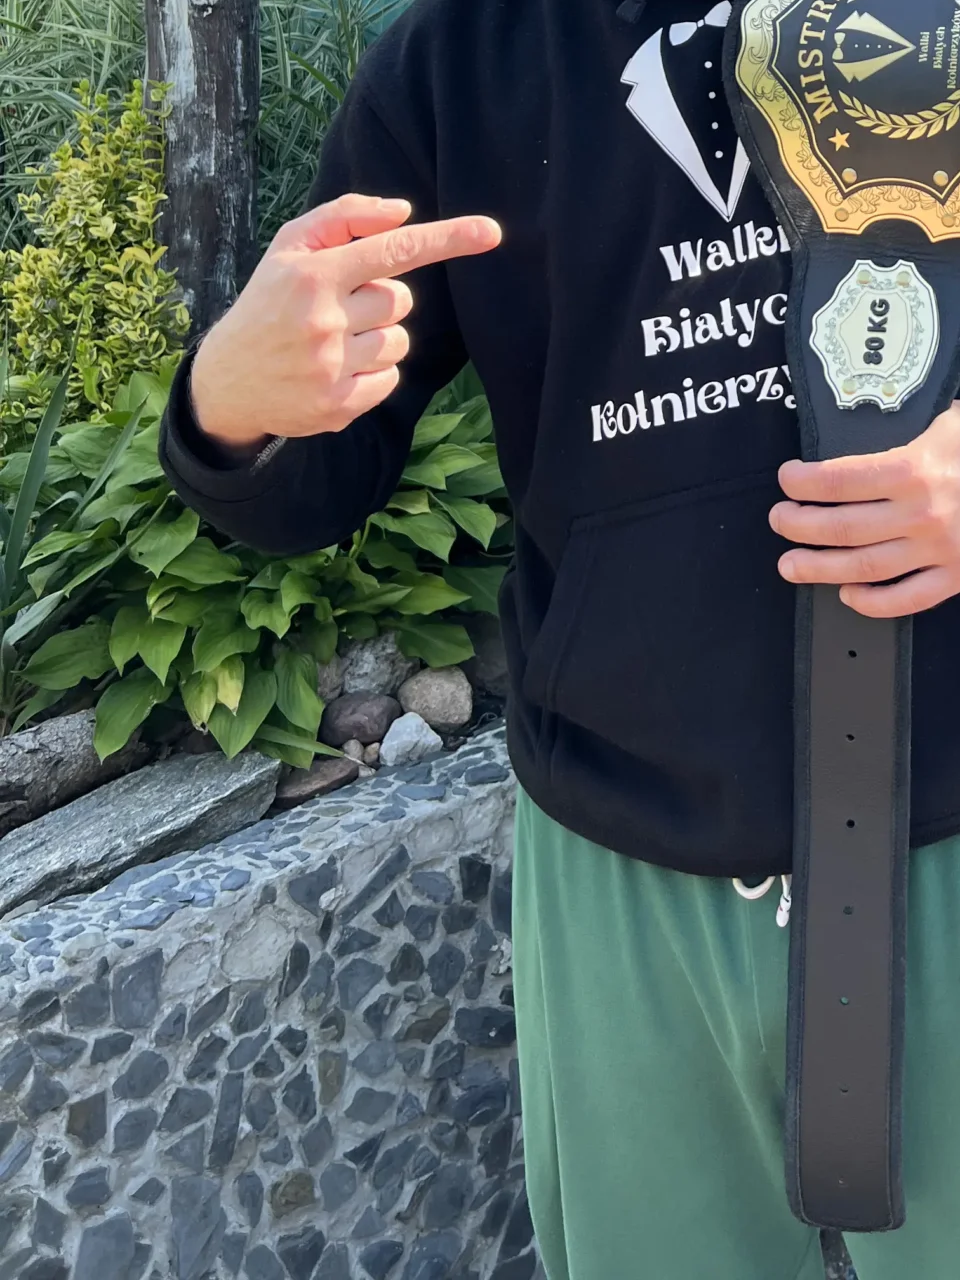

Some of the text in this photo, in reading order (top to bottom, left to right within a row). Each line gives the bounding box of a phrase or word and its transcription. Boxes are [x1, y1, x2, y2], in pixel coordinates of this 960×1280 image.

[918, 31, 930, 62] Walki
[862, 298, 890, 365] 80 KG
